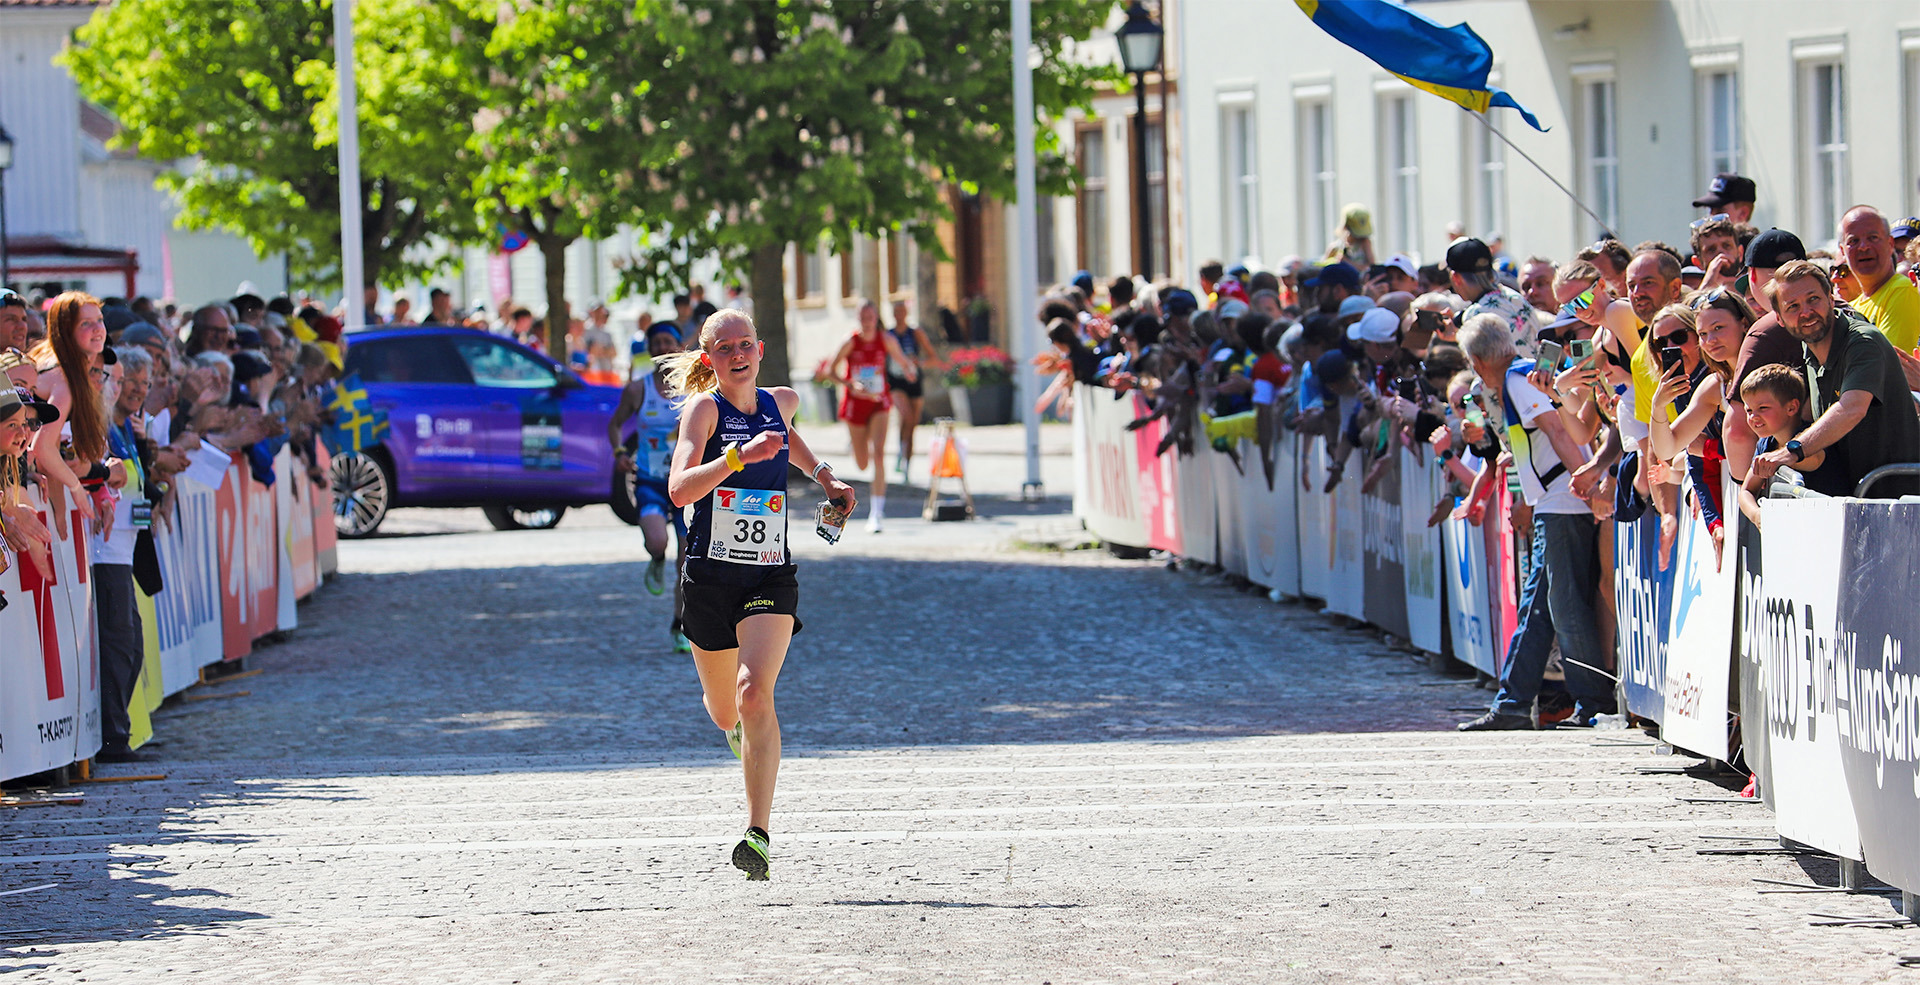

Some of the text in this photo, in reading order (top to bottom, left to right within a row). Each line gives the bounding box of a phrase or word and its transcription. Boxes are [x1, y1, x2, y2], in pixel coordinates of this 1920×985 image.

[734, 519, 766, 544] 38
[774, 533, 780, 543] 4
[761, 548, 783, 563] SKARA
[744, 600, 774, 610] SWEDEN
